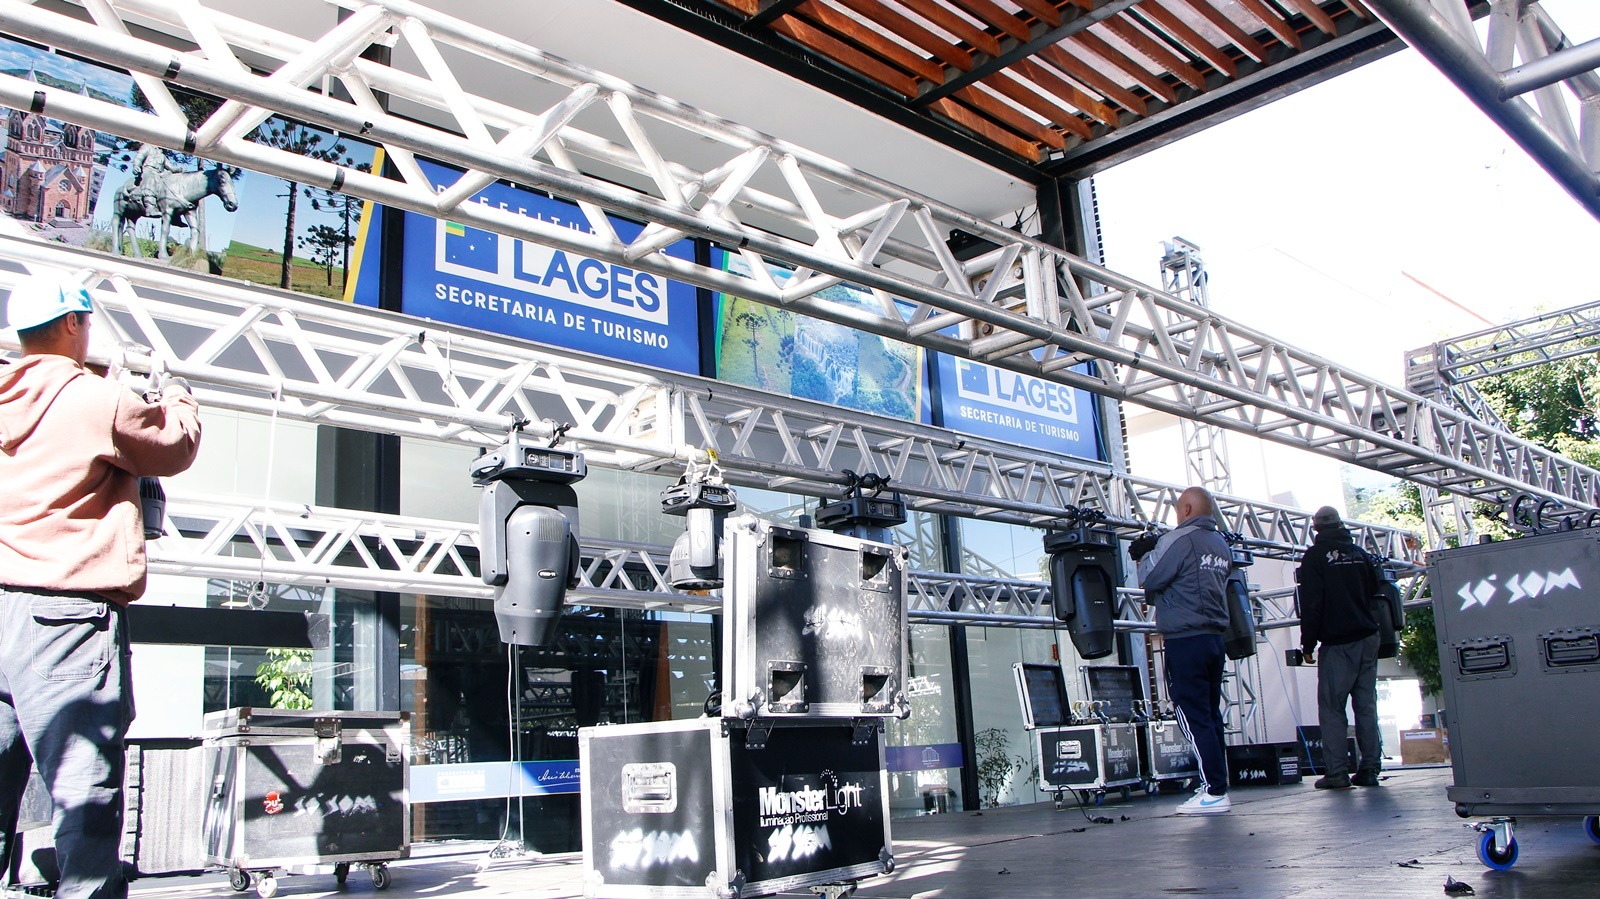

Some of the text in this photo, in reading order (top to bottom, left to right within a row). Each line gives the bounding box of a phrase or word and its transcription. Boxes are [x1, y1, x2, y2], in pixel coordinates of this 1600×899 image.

[513, 239, 660, 313] LAGES
[435, 283, 669, 350] SECRETARIA DE TURISMO
[994, 368, 1073, 416] LAGES
[960, 405, 1080, 442] SECRETARIA DE TURISMO
[1505, 567, 1582, 604] SOM
[1250, 769, 1268, 780] SOM
[322, 795, 379, 818] SOM
[794, 811, 829, 824] Profissional
